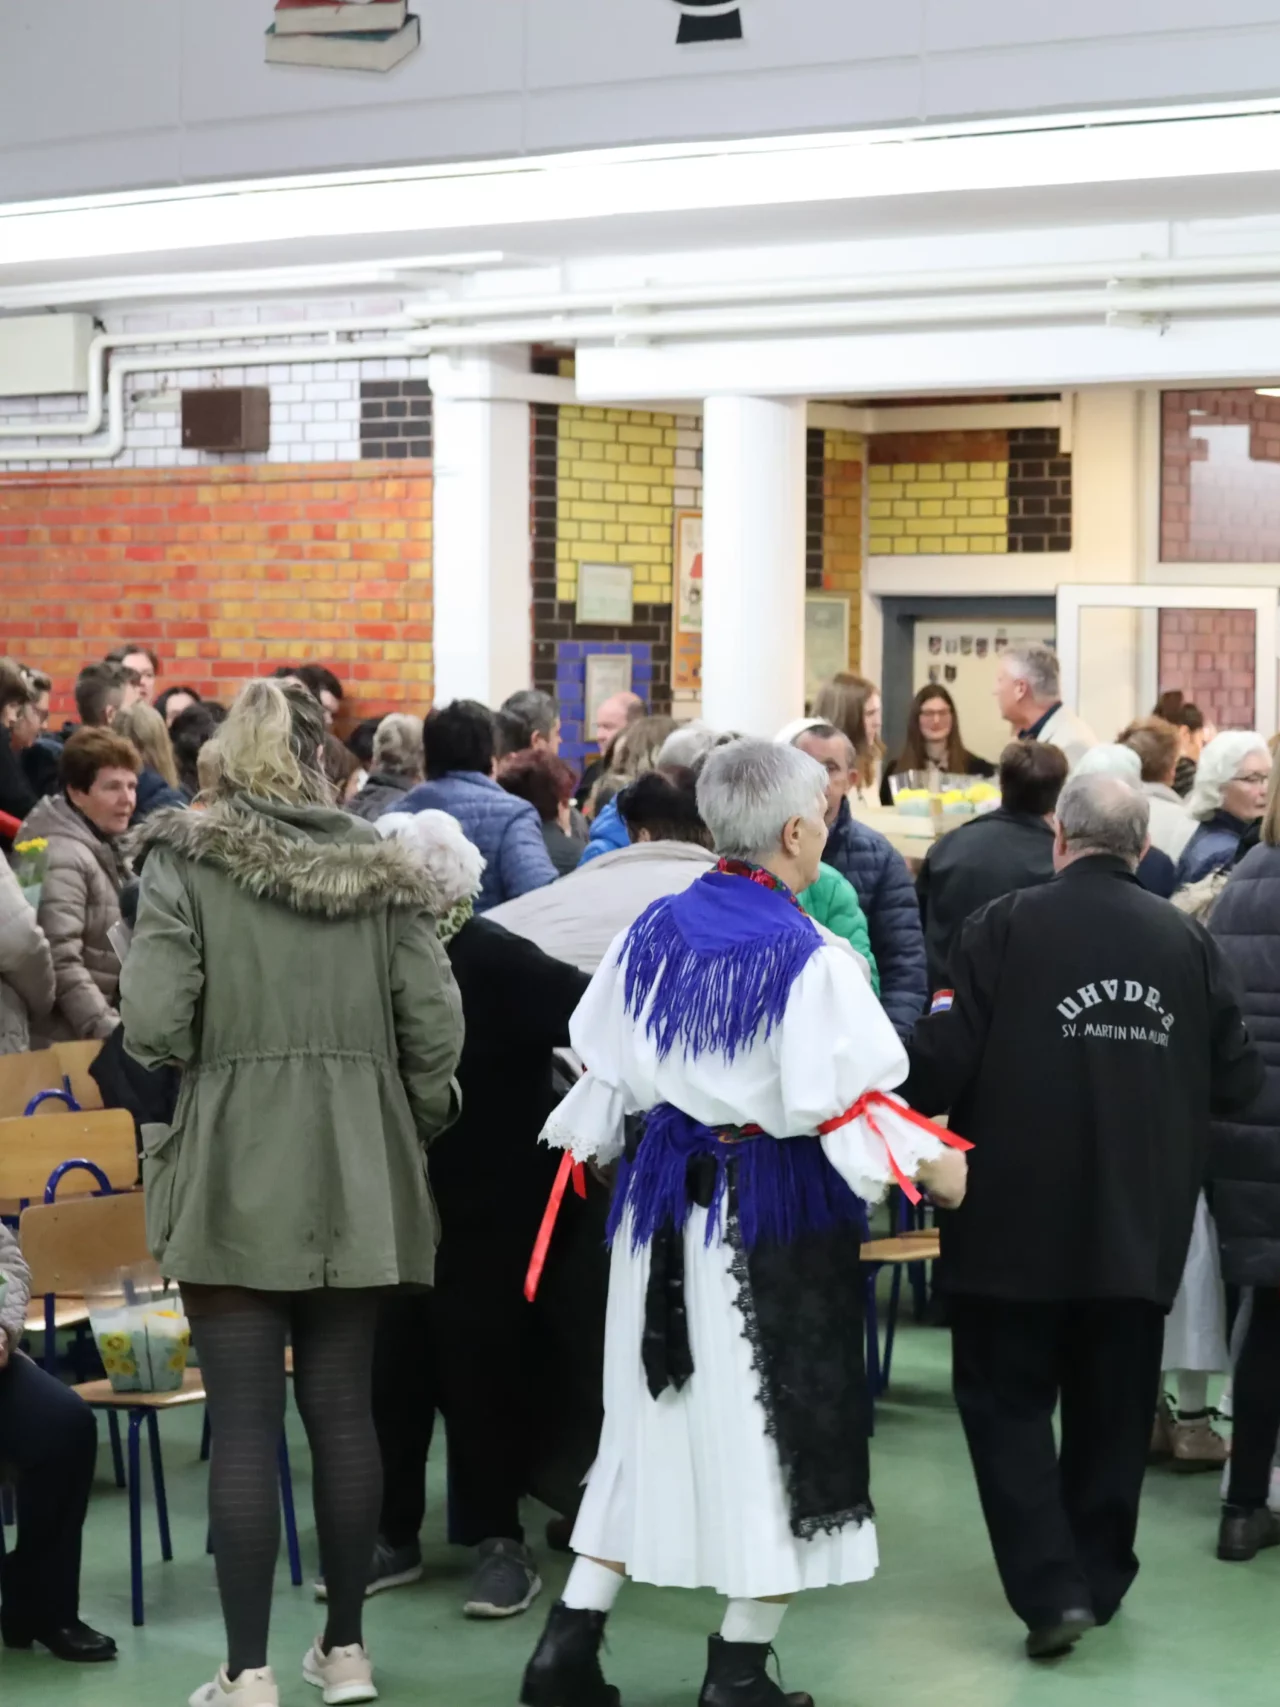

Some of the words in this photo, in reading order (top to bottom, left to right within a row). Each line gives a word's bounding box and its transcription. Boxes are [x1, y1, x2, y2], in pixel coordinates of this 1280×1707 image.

[1061, 1023, 1081, 1038] SV.
[1084, 1022, 1127, 1040] MARTIN
[1130, 1026, 1147, 1041] NA
